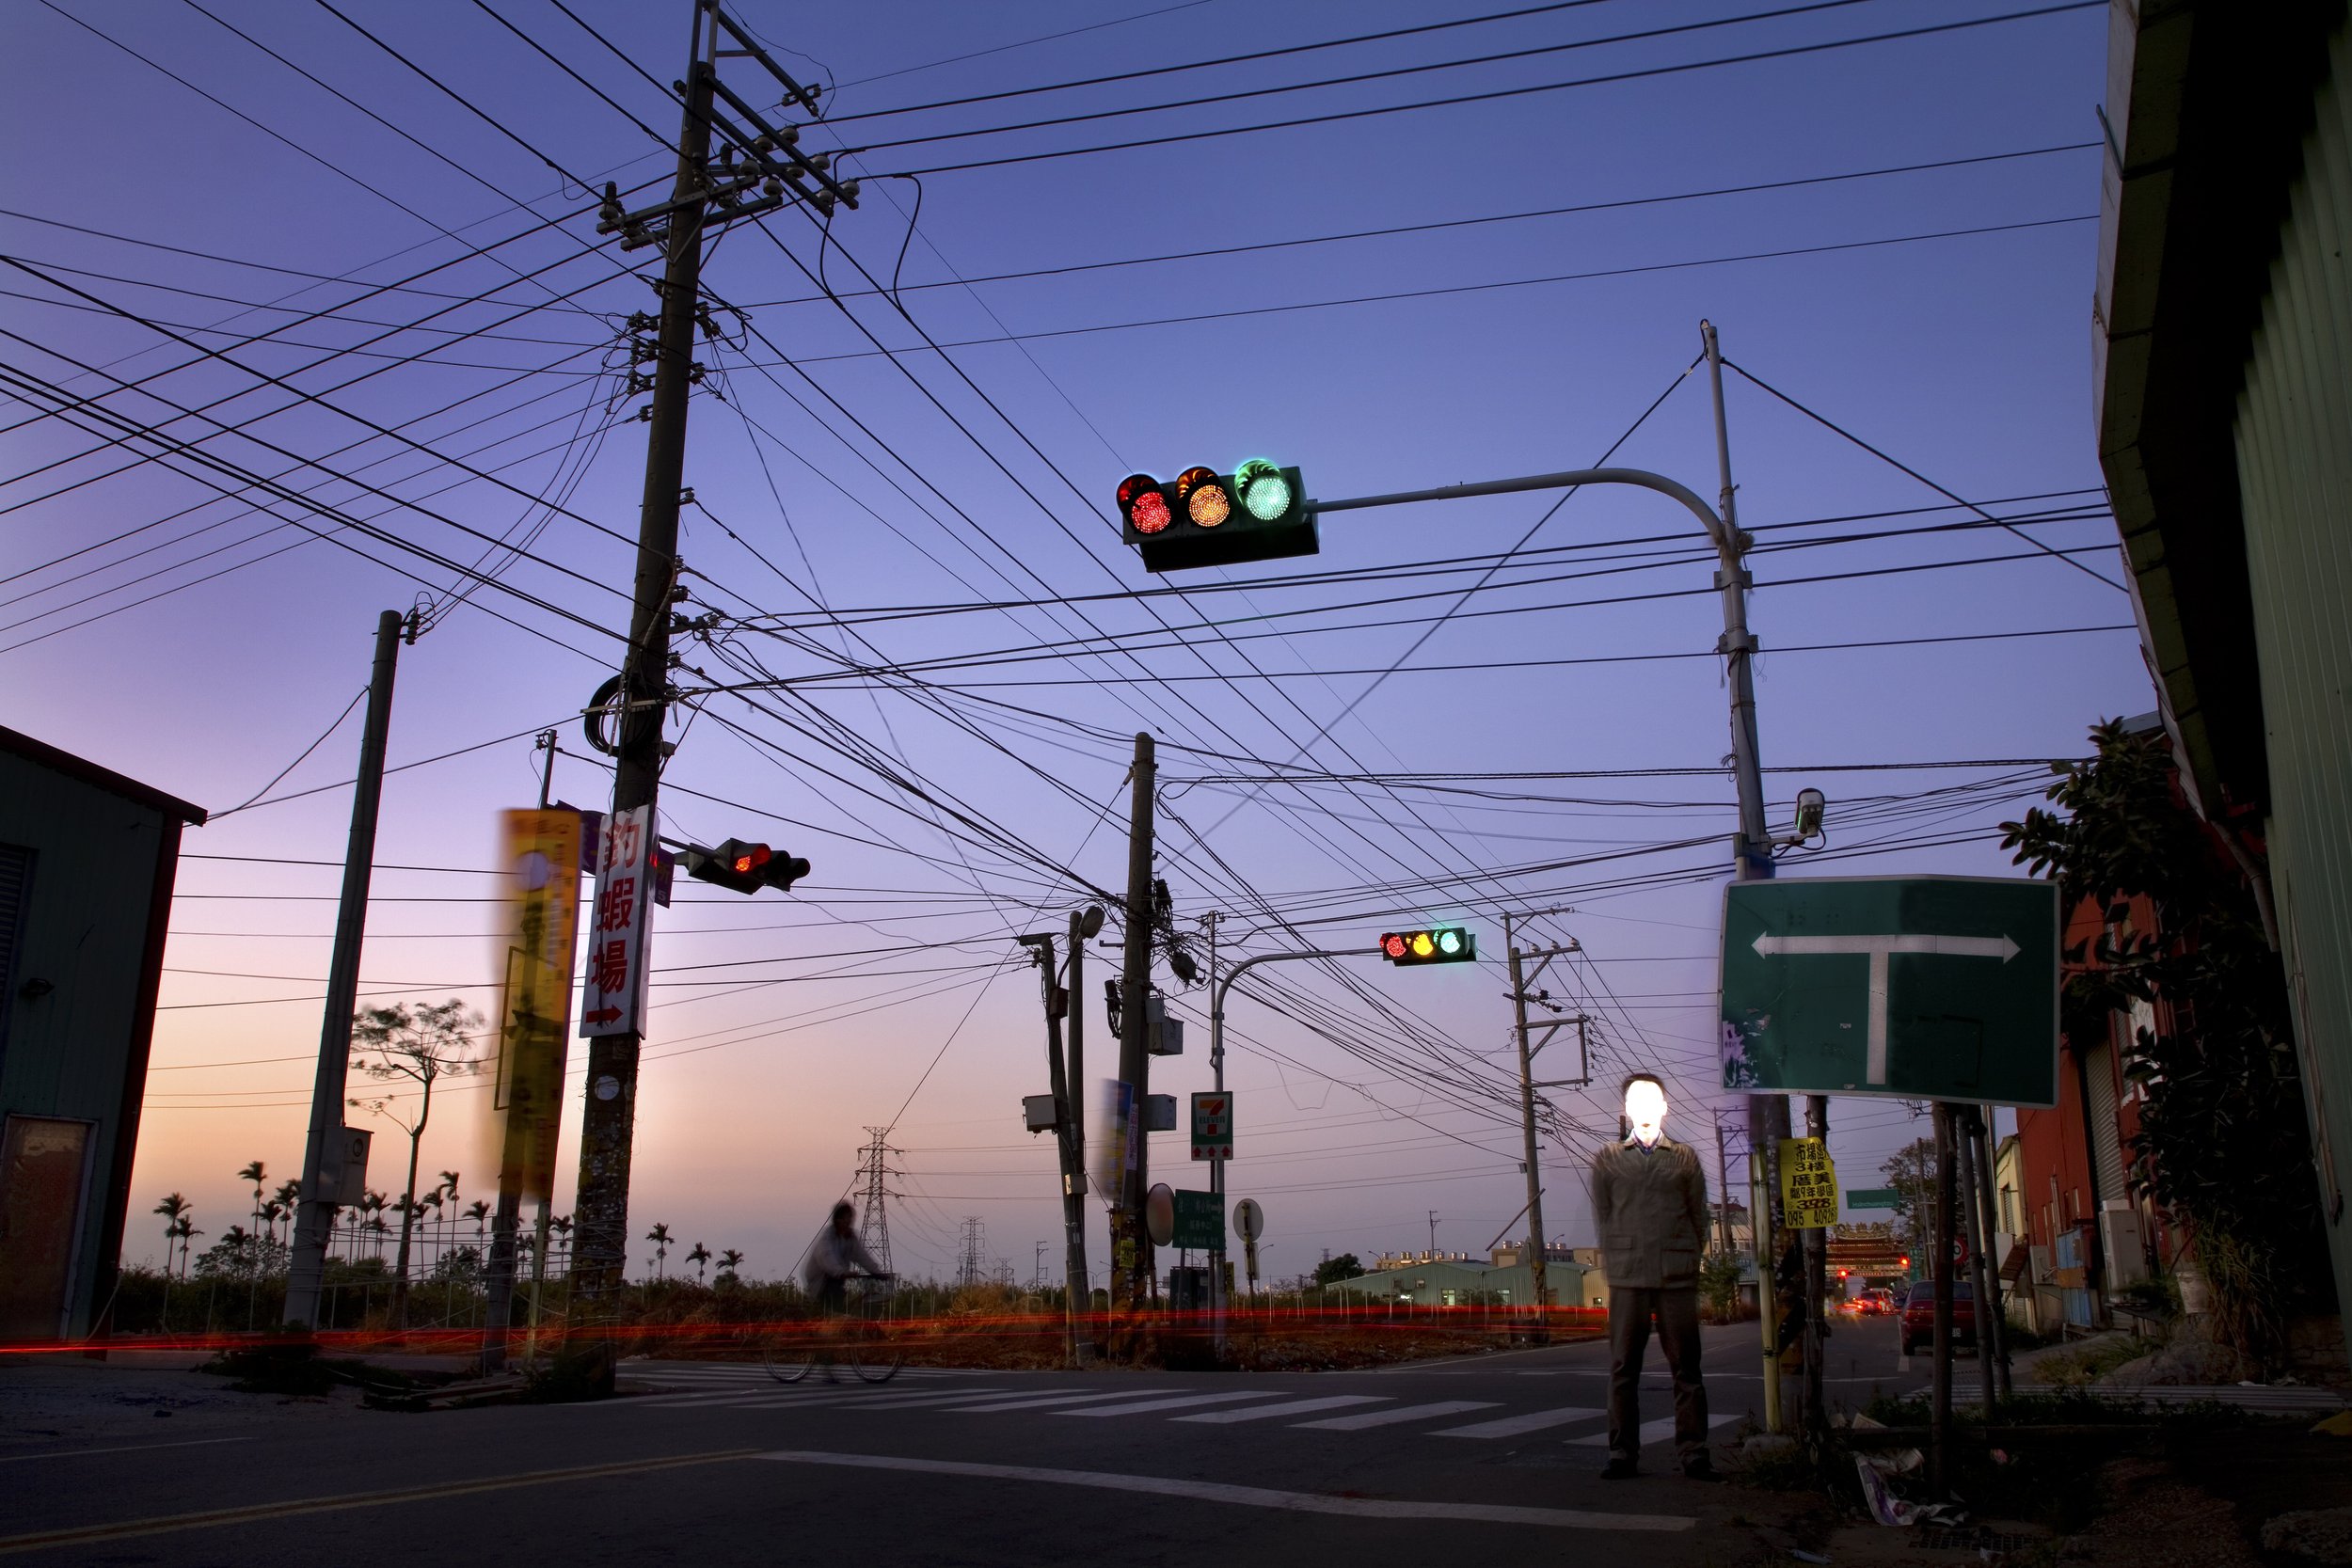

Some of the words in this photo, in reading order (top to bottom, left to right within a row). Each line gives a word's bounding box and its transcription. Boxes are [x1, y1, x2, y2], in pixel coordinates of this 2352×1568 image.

[591, 816, 641, 995] 釣蝦場
[1200, 1099, 1225, 1135] 7
[1787, 1211, 1804, 1227] 095
